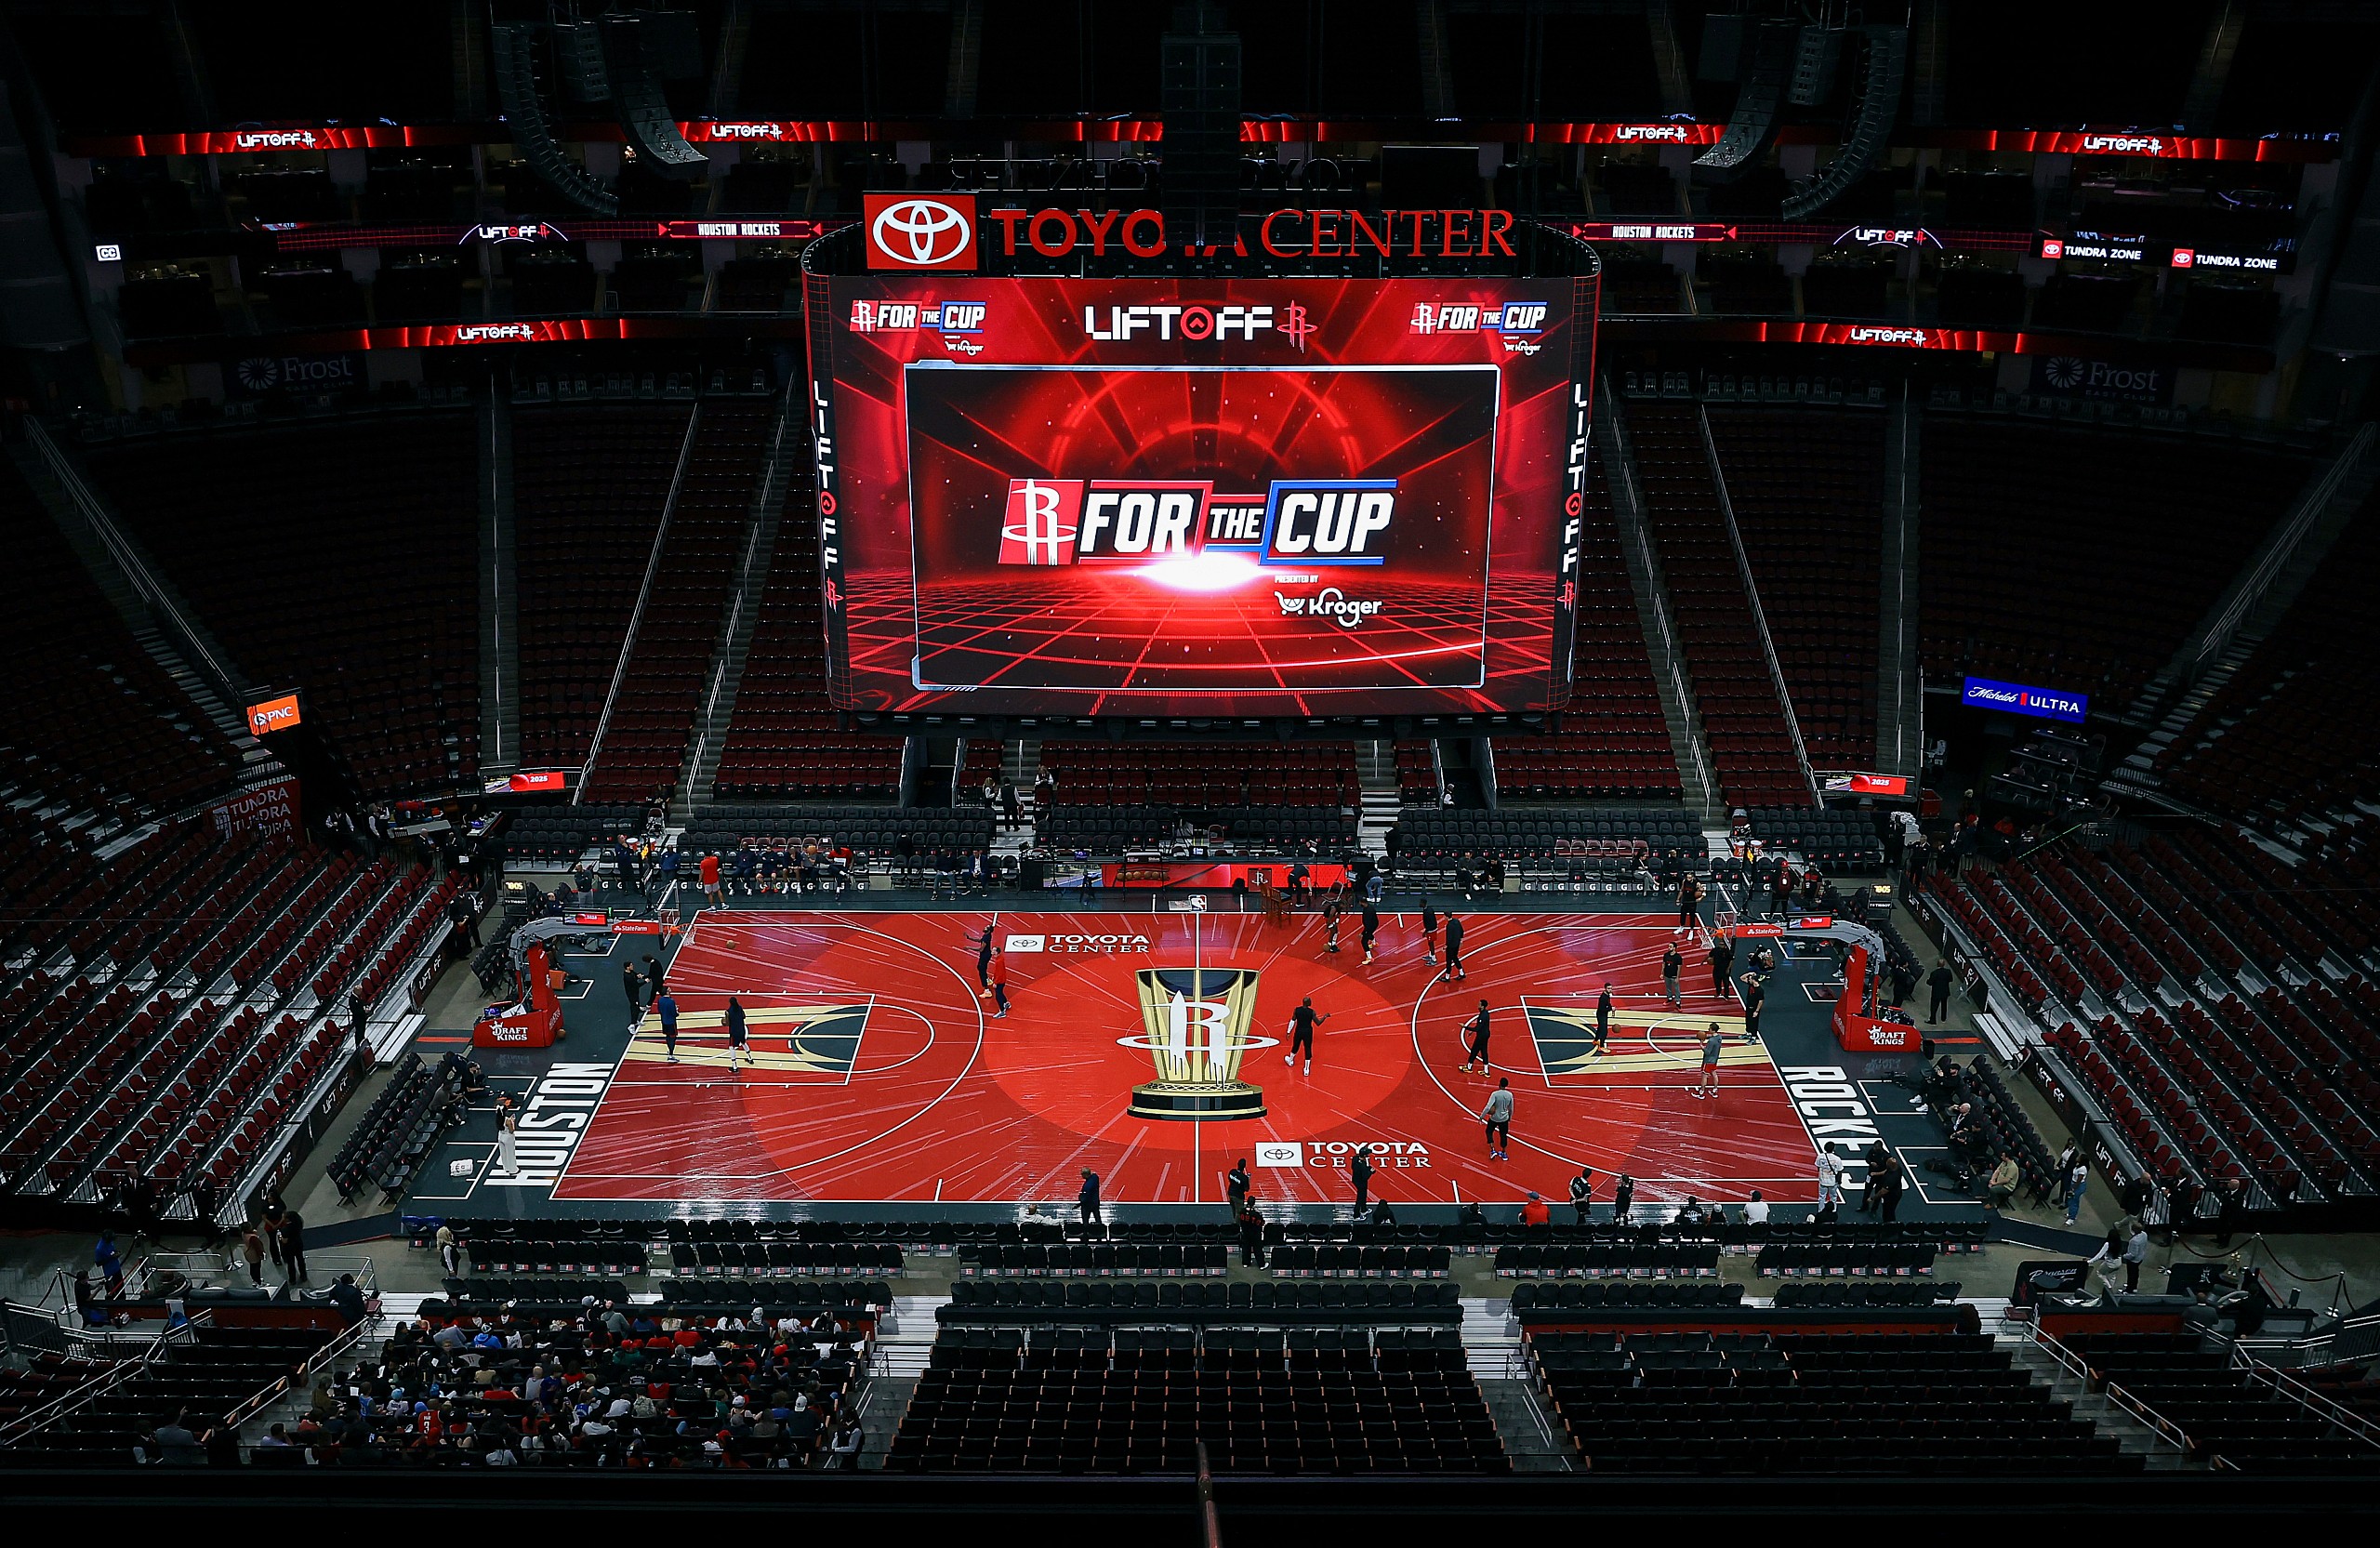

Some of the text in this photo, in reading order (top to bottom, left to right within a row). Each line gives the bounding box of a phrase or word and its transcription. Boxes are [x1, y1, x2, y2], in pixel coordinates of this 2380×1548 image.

[711, 125, 770, 138] LIFTOFF
[1617, 126, 1675, 139] LIFTOFF
[237, 133, 301, 147] LIFTOFF
[2083, 136, 2149, 152] LIFTOFF
[479, 225, 536, 239] LIFTOFF
[698, 223, 781, 236] HOUSTON ROCKETS
[991, 208, 1517, 258] TOYO CENTER
[1612, 225, 1695, 239] HOUSTON ROCKETS
[1855, 229, 1913, 242] LIFTOFF
[99, 246, 116, 258] CC
[2064, 245, 2142, 260] TUNDRA ZONE
[2195, 254, 2278, 270] TUNDRA ZONE
[877, 304, 918, 328] FOR
[921, 311, 941, 324] THE
[944, 305, 986, 329] CUP
[1085, 305, 1274, 341] LIFTOFF
[1437, 306, 1479, 330] FOR
[1482, 311, 1502, 324] THE
[1504, 306, 1547, 330] CUP
[457, 325, 520, 340] LIFTOFF
[1851, 327, 1912, 343] LIFTOFF
[957, 339, 984, 356] Kroger
[1514, 339, 1541, 356] Kroger
[281, 355, 353, 382] Frost
[2086, 361, 2160, 390] Frost
[813, 379, 839, 570] LIFTOFF
[1562, 382, 1588, 574] LIFTOFF
[1079, 493, 1196, 554] FOR
[1210, 508, 1265, 539] THE
[1274, 492, 1395, 554] CUP
[1274, 576, 1319, 584] PRESENTED BY
[1308, 587, 1382, 628] Kroger
[1967, 686, 2081, 714] Michelob ULTRA
[267, 706, 294, 722] PNC
[530, 774, 549, 784] 2025
[1871, 777, 1890, 787] 2025
[230, 787, 290, 816] TUNDRA
[1050, 933, 1150, 945] TOYOTA
[1049, 945, 1150, 954] CENTER
[492, 1026, 529, 1038] DRAFT
[496, 1033, 528, 1041] KINGS
[1869, 1031, 1907, 1040] DRAFT
[483, 1062, 615, 1186] HOUSTON
[1307, 1141, 1430, 1155] TOYOTA
